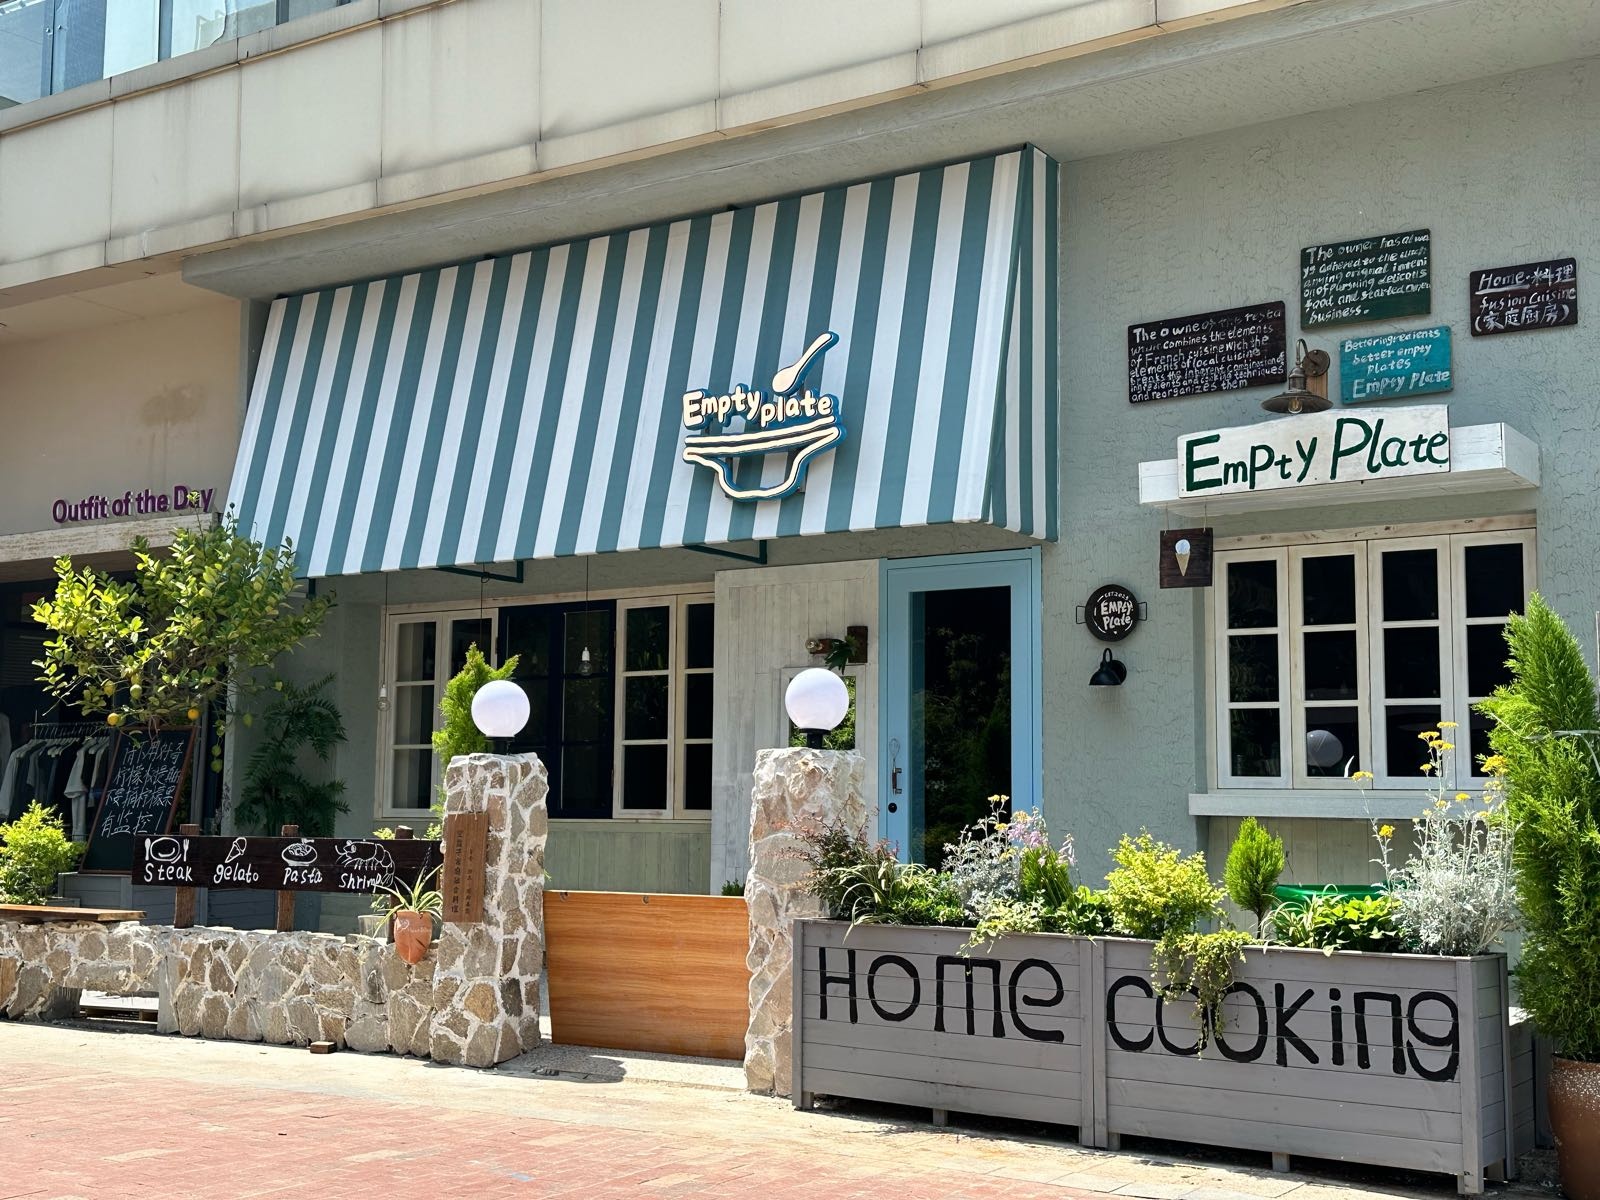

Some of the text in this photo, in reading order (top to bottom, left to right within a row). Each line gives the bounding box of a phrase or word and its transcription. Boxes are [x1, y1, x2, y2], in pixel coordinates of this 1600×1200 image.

[1306, 247, 1333, 264] The
[1338, 241, 1376, 256] owner
[1338, 291, 1359, 305] and
[1132, 328, 1157, 343] The
[1162, 335, 1207, 350] combines
[1209, 330, 1225, 342] the
[1129, 360, 1178, 378] elements
[1221, 347, 1261, 363] cuisine
[1130, 354, 1143, 369] of
[1145, 349, 1185, 367] French
[1131, 388, 1149, 402] and
[1221, 378, 1248, 391] them
[683, 385, 832, 428] Empty plate
[1185, 417, 1449, 492] Empty Plate
[53, 495, 109, 523] Outfit
[112, 491, 132, 516] of
[135, 489, 169, 513] the
[144, 863, 193, 882] Steak
[213, 862, 259, 884] gelato
